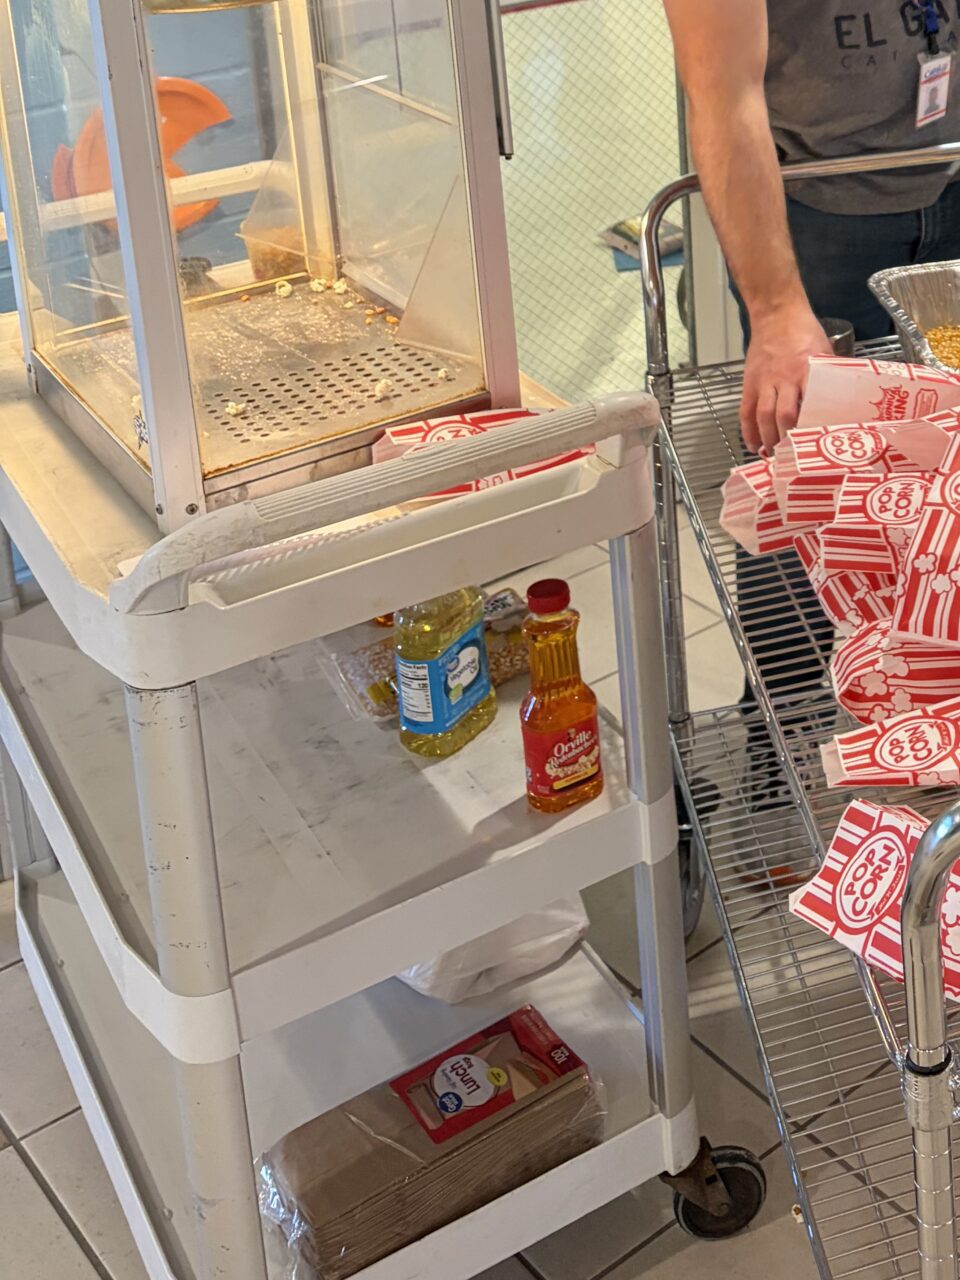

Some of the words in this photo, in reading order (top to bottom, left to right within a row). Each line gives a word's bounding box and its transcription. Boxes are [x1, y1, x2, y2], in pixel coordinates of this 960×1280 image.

[834, 12, 887, 50] EL
[831, 434, 849, 456] POP
[878, 486, 895, 514] POP
[893, 482, 916, 519] CORN
[553, 730, 592, 757] Orville
[889, 738, 910, 764] POP
[904, 724, 933, 762] CORN
[843, 848, 876, 896] POP
[851, 843, 896, 916] CORN
[450, 1060, 481, 1096] Lunch
